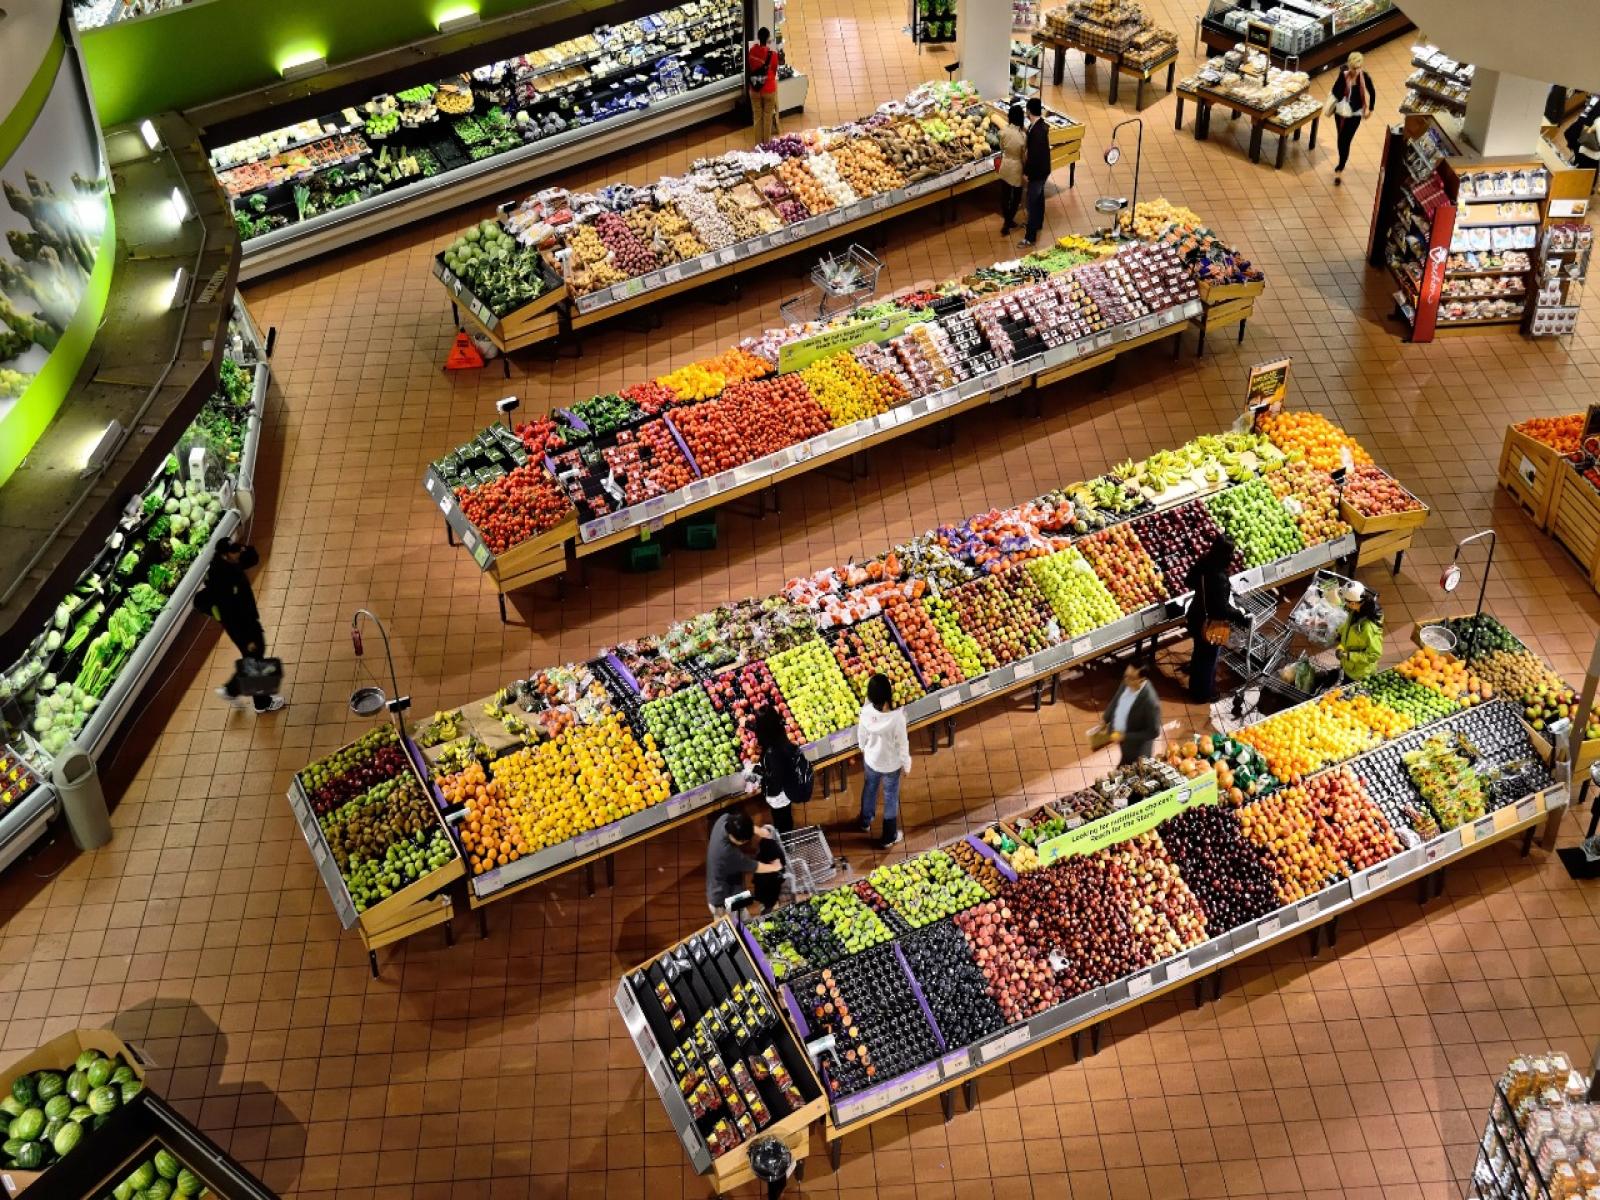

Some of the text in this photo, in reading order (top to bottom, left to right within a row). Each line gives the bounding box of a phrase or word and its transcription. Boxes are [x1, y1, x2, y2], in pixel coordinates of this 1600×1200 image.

[1072, 828, 1098, 843] Looking
[1100, 822, 1110, 830] for
[1145, 794, 1174, 811] choices?
[1090, 830, 1111, 842] Reach
[1112, 824, 1121, 833] for
[1123, 818, 1135, 829] the
